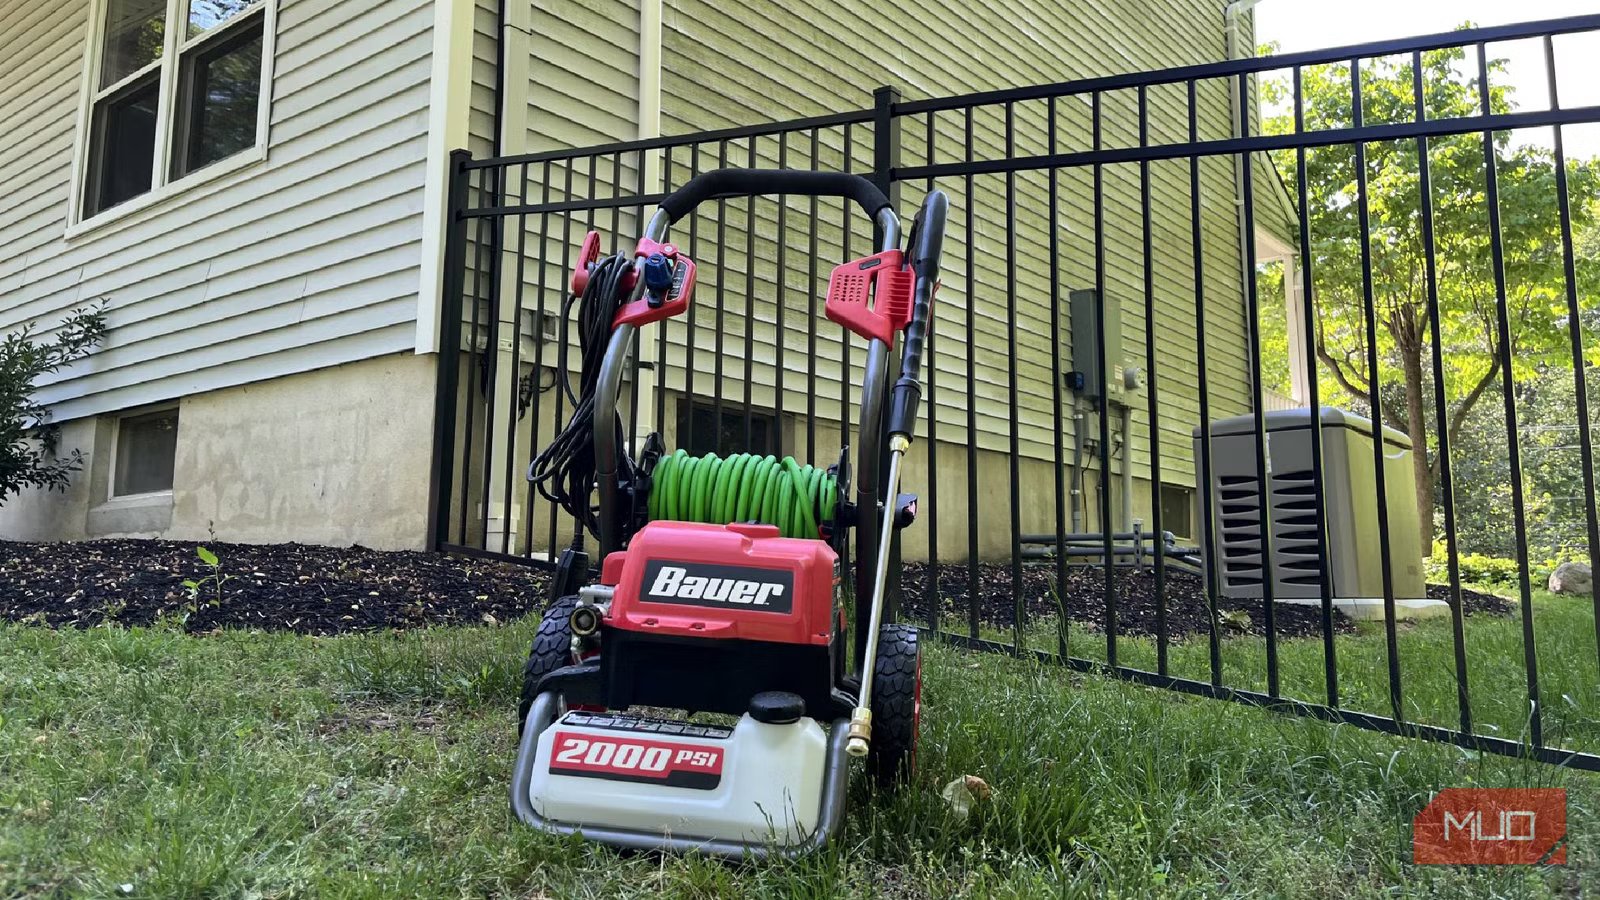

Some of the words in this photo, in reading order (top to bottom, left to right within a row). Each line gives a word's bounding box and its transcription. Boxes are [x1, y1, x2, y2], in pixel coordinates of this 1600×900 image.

[649, 566, 784, 605] Bauer
[556, 738, 672, 772] 2000
[674, 750, 718, 768] PSI
